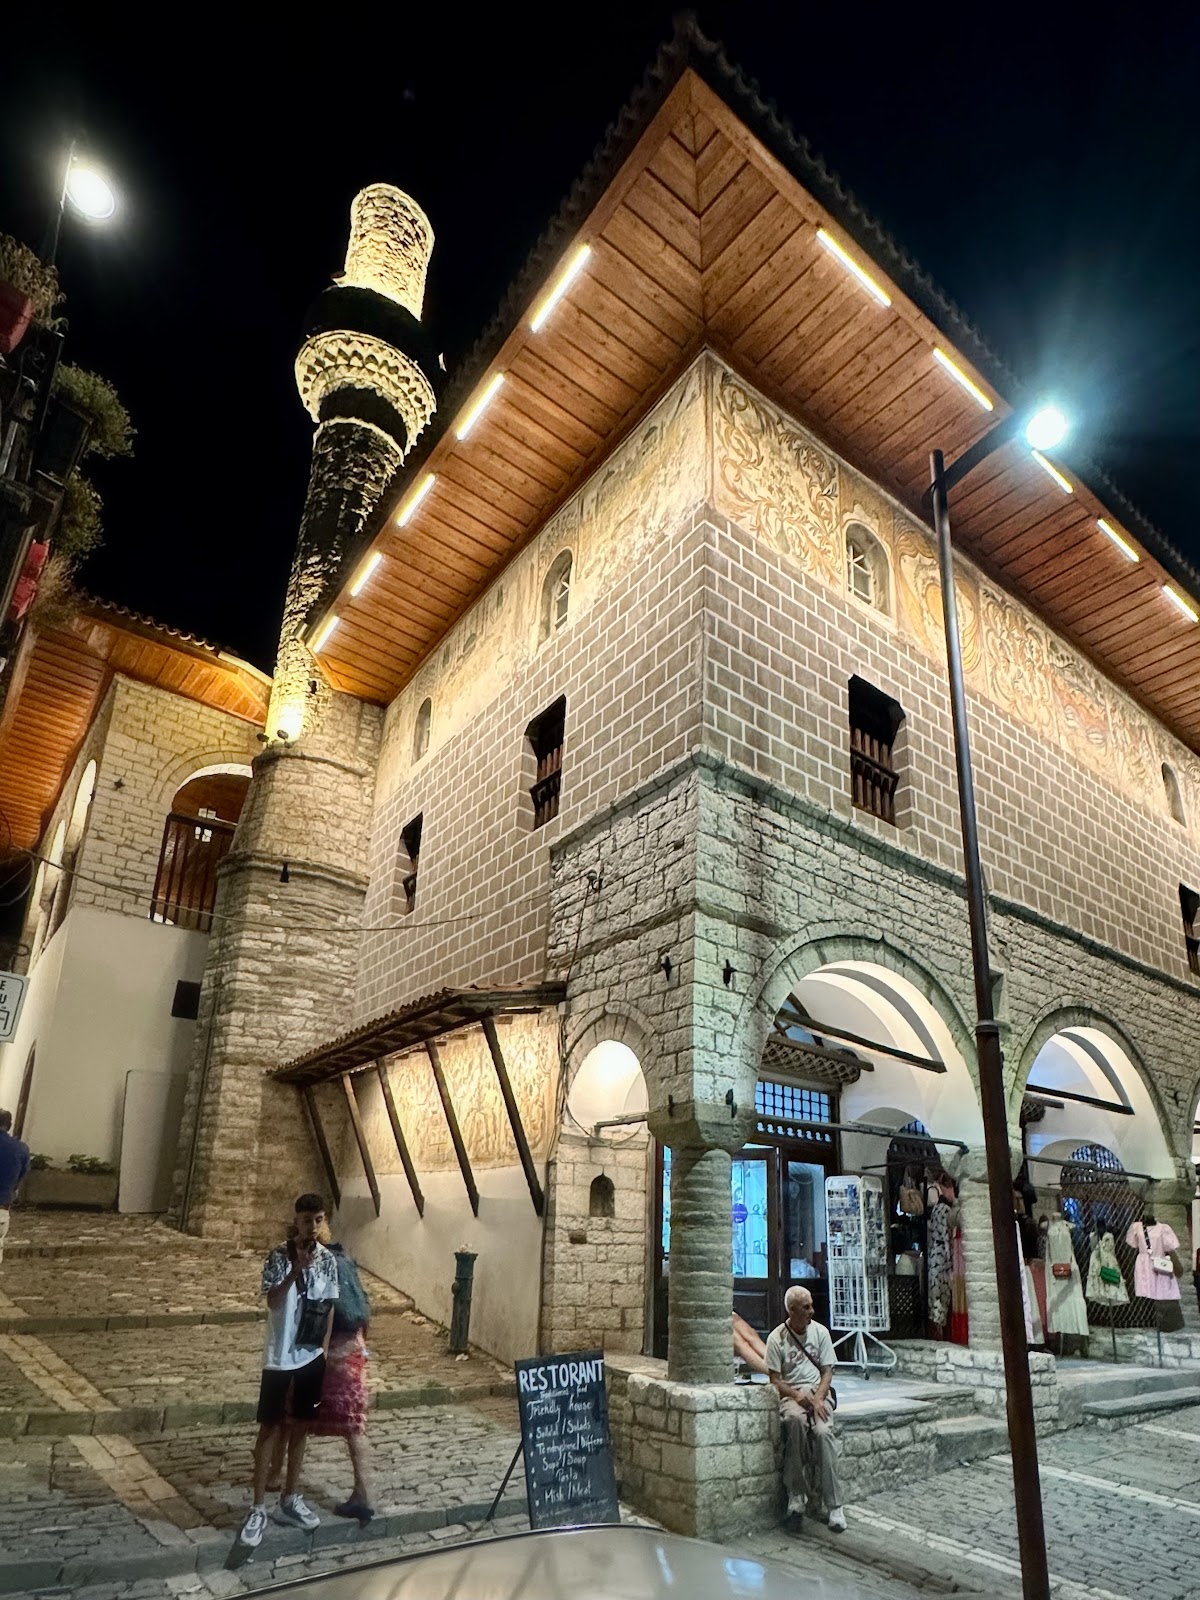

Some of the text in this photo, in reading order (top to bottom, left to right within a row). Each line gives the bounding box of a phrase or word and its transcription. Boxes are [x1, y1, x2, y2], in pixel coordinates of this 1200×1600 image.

[518, 1359, 604, 1393] RESTORANT
[526, 1393, 592, 1422] Friendly house
[555, 1466, 578, 1482] Pasta
